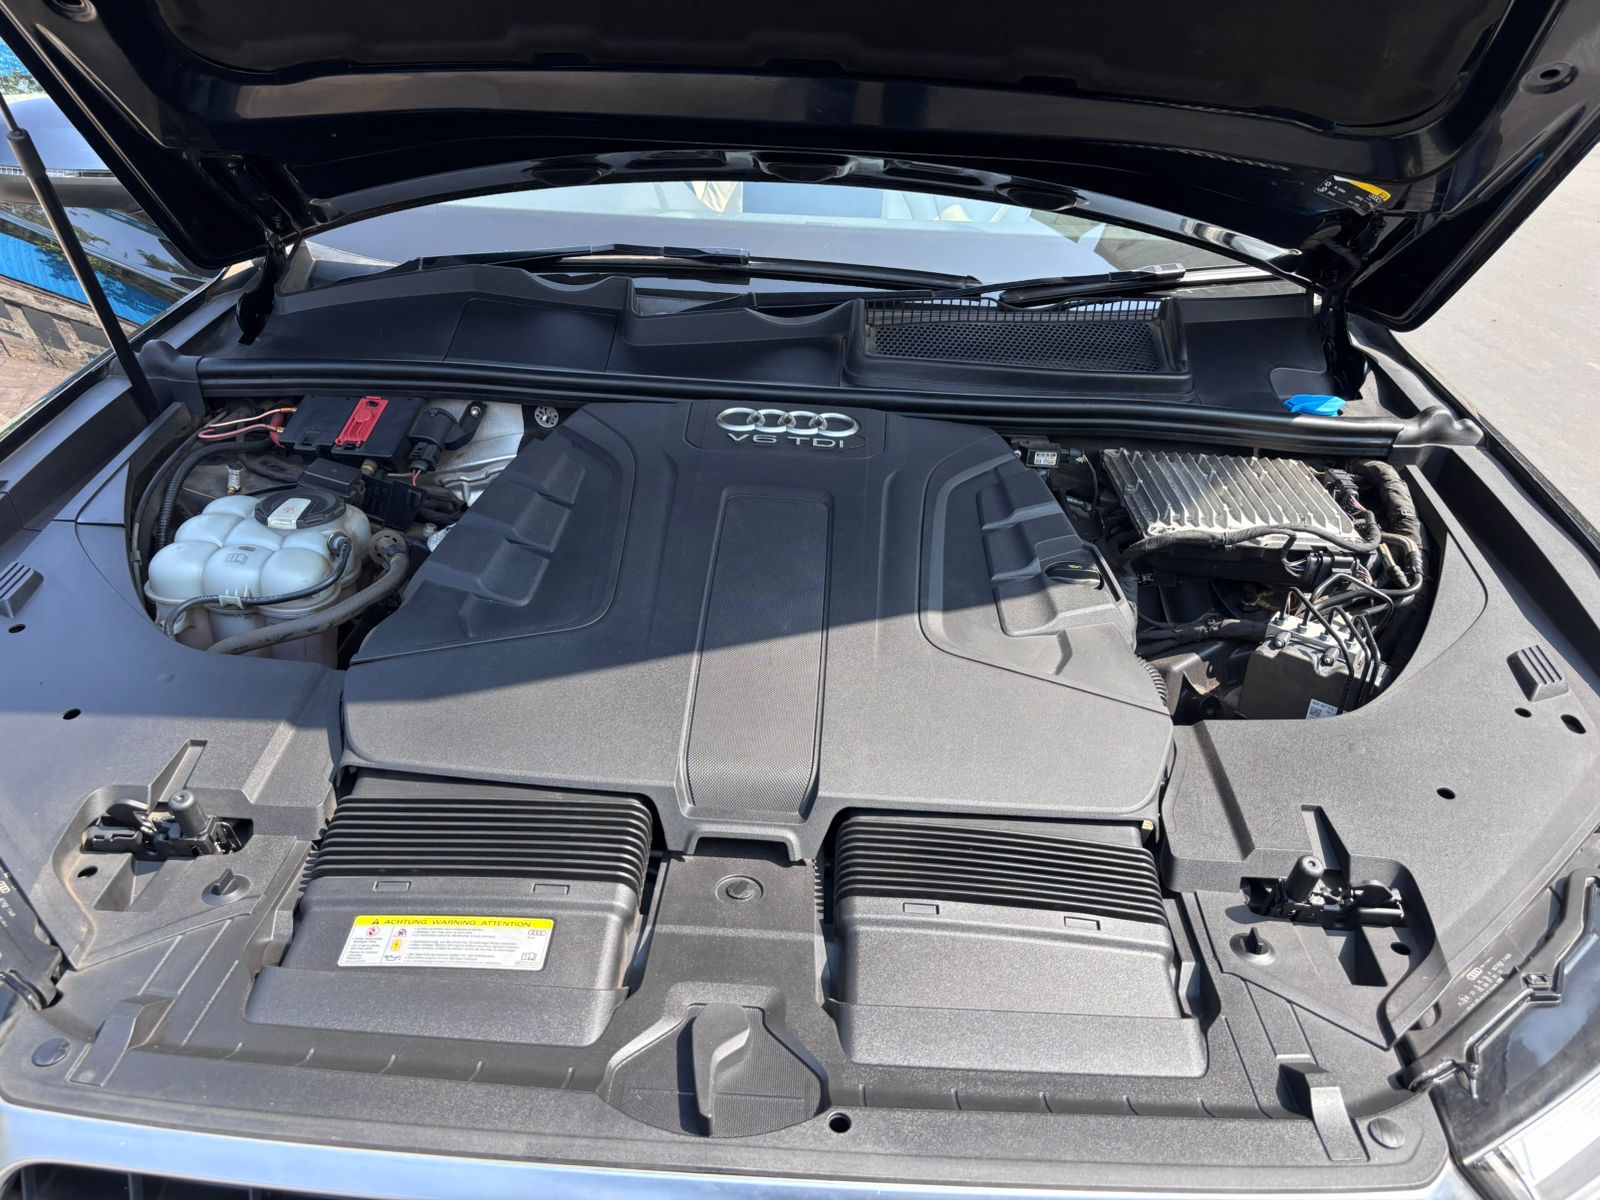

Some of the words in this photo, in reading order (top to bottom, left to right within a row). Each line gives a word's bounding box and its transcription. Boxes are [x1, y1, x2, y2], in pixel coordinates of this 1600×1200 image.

[728, 433, 777, 444] V6
[787, 435, 844, 448] TDI
[480, 920, 531, 928] ATTENTION
